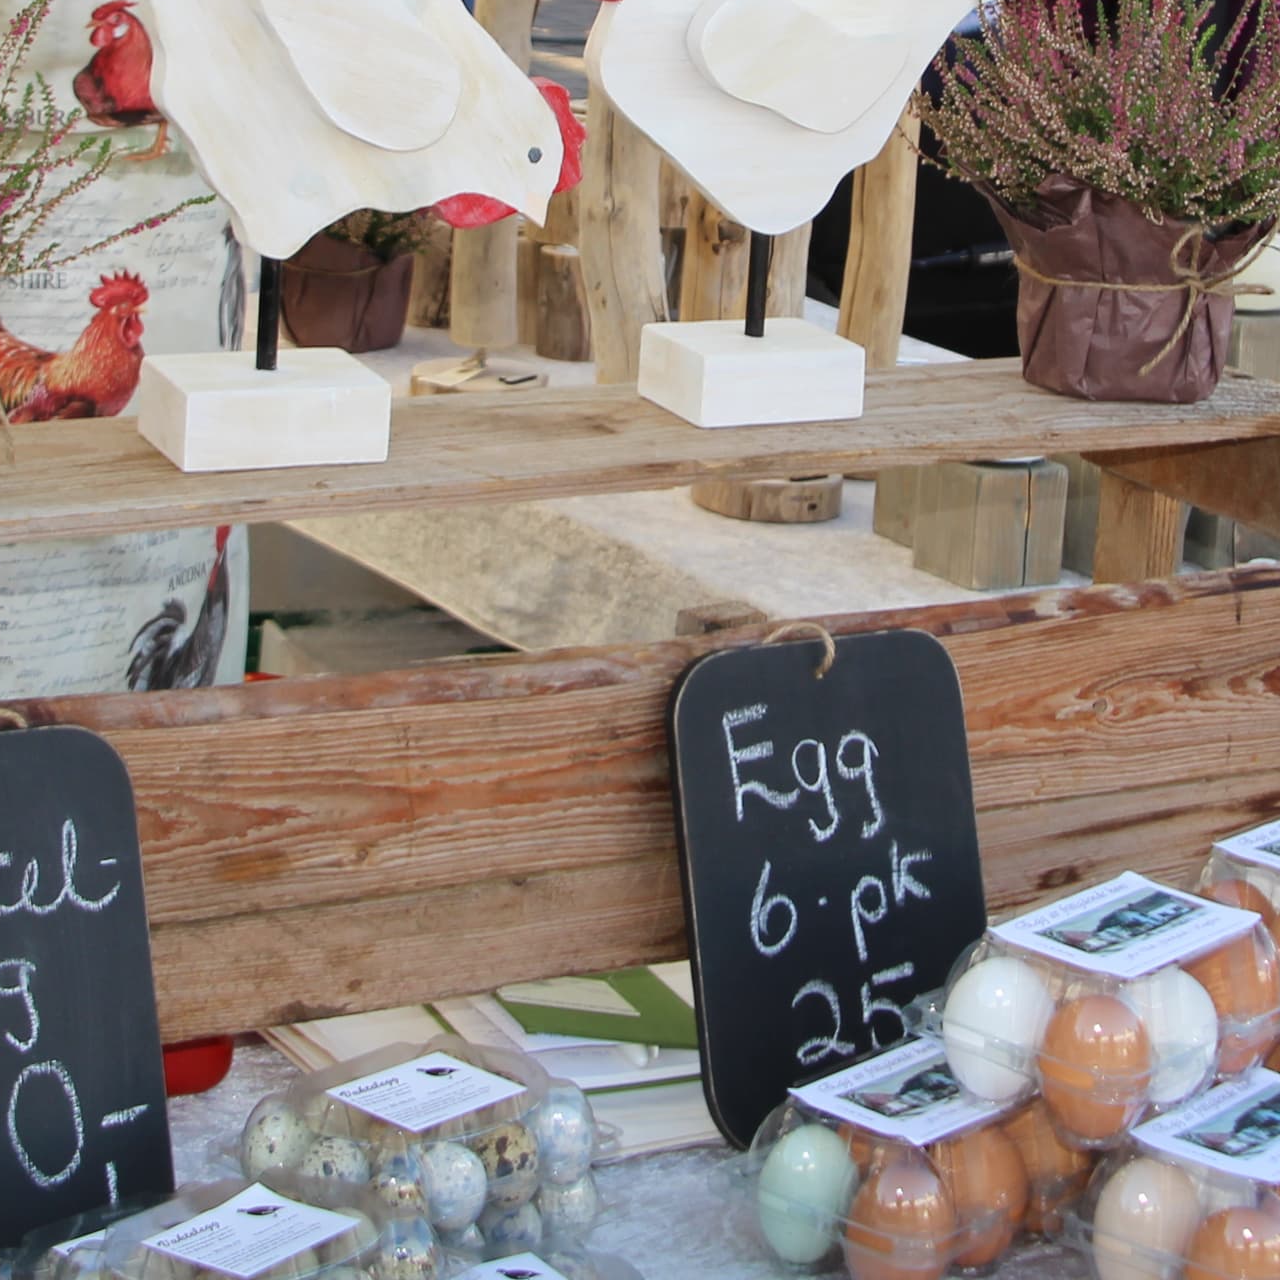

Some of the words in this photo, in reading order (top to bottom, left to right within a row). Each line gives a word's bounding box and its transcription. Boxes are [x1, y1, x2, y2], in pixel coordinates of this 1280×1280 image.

[723, 704, 888, 841] Egg
[339, 1077, 400, 1098] Vaktelegg
[157, 1220, 221, 1248] Vaktelegg
